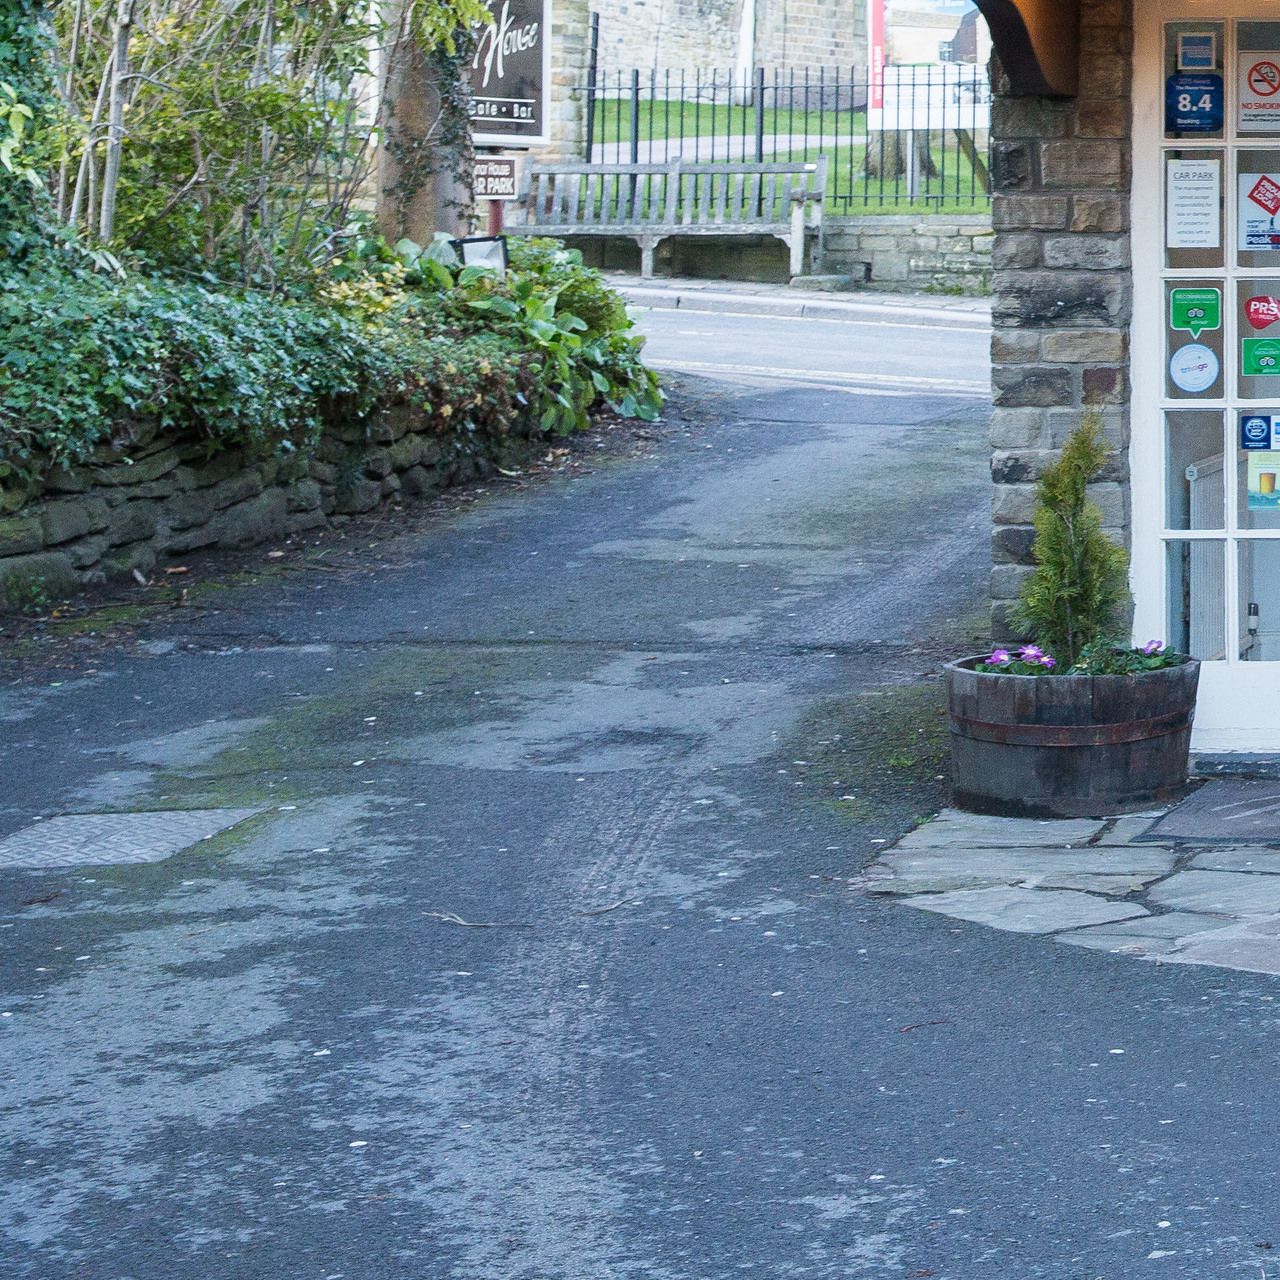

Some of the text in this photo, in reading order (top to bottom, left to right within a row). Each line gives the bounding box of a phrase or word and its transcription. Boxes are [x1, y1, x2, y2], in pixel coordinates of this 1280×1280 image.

[472, 0, 539, 88] House
[513, 103, 533, 119] Bar
[1177, 94, 1213, 112] 8.4
[1173, 171, 1214, 180] CAR PARK
[487, 177, 514, 194] PARK
[1250, 301, 1278, 315] PRS
